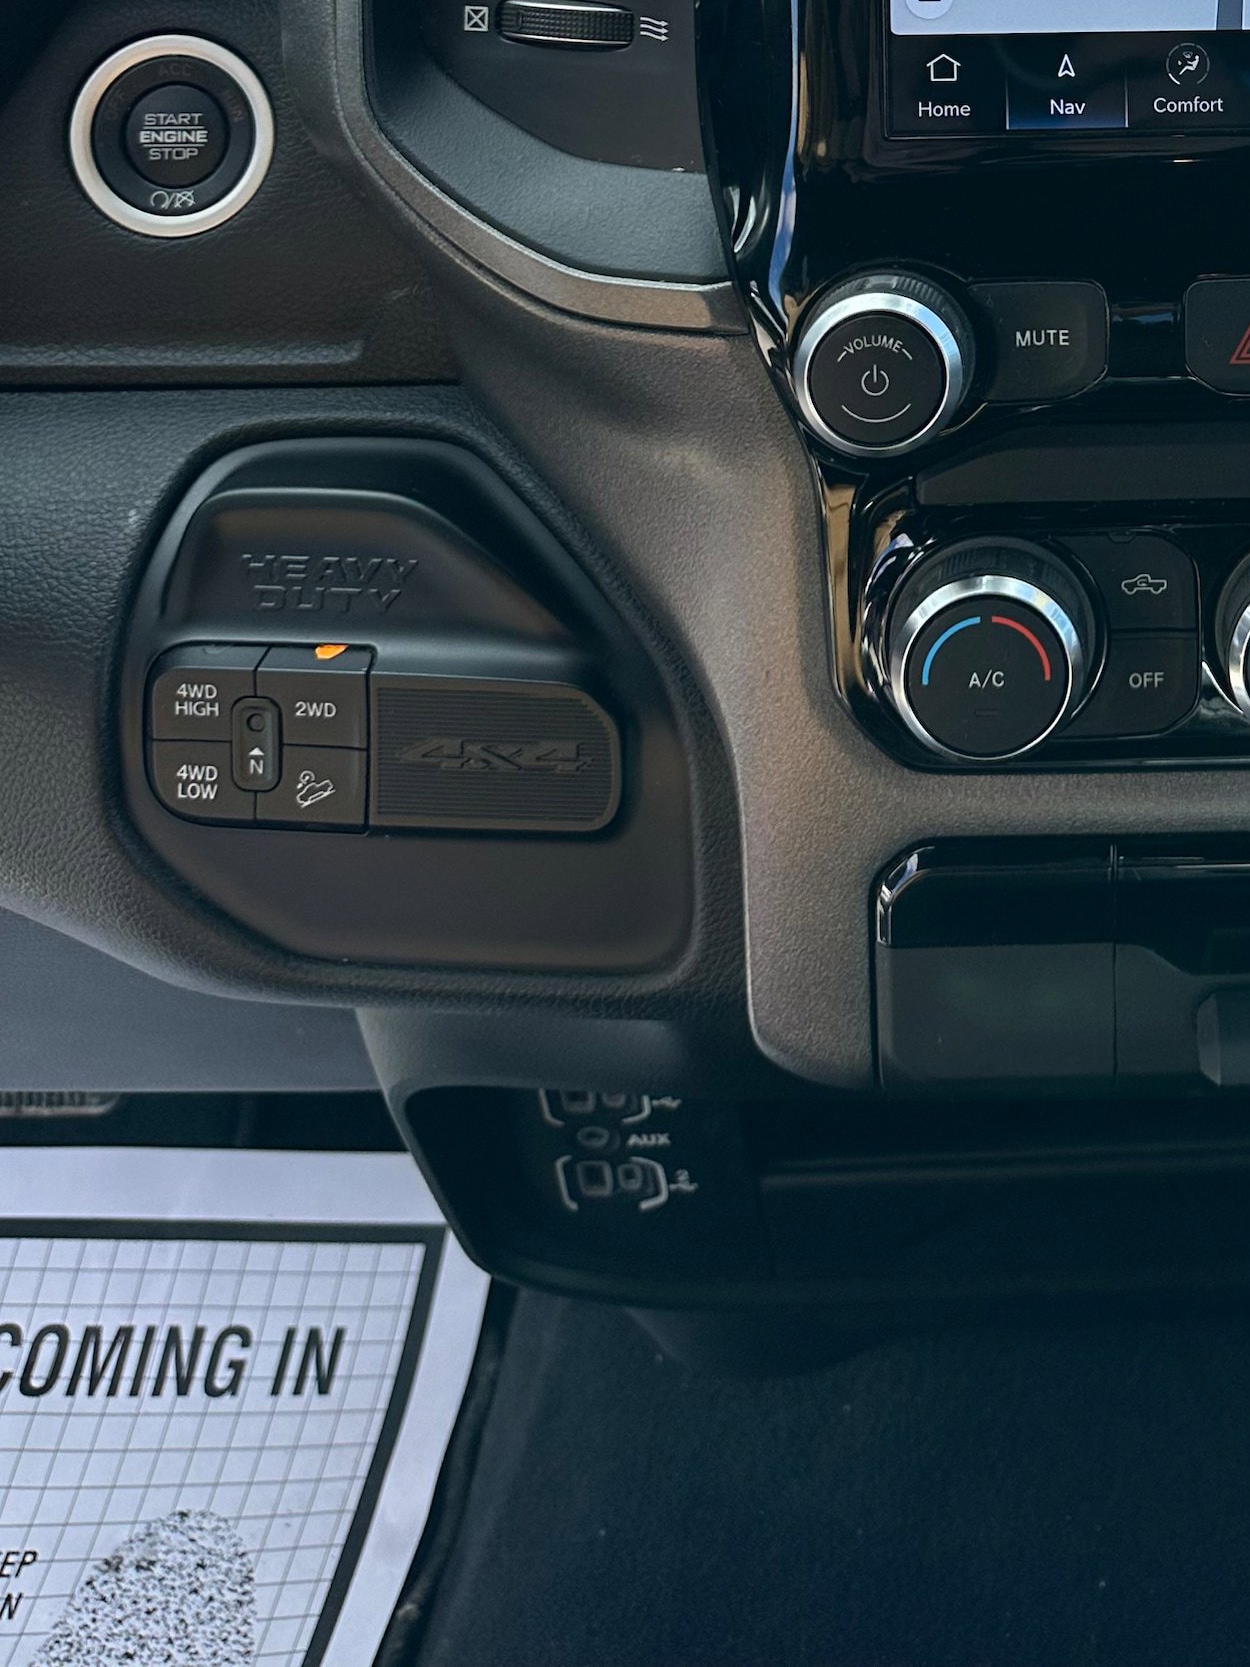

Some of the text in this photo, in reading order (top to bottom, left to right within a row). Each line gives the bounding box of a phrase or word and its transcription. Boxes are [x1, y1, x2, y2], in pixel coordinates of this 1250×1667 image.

[918, 102, 971, 117] Home
[1050, 99, 1085, 115] Nav
[1153, 97, 1223, 113] Comfort
[144, 113, 203, 126] START
[139, 130, 208, 144] ENGINE
[149, 148, 199, 160] STOP
[845, 335, 903, 355] VOLUME
[1016, 330, 1069, 347] MUTE
[241, 554, 418, 584] HEAVY
[254, 585, 401, 612] DUTY
[969, 670, 1004, 688] A/C
[1129, 672, 1164, 688] OFF
[176, 683, 217, 700] 4WD
[175, 700, 219, 717] HIGH
[295, 701, 337, 718] 2WD
[176, 765, 218, 782] 4WD
[249, 759, 263, 775] N
[177, 783, 218, 800] LOW
[627, 1133, 670, 1146] AUX
[271, 1326, 346, 1396] IN
